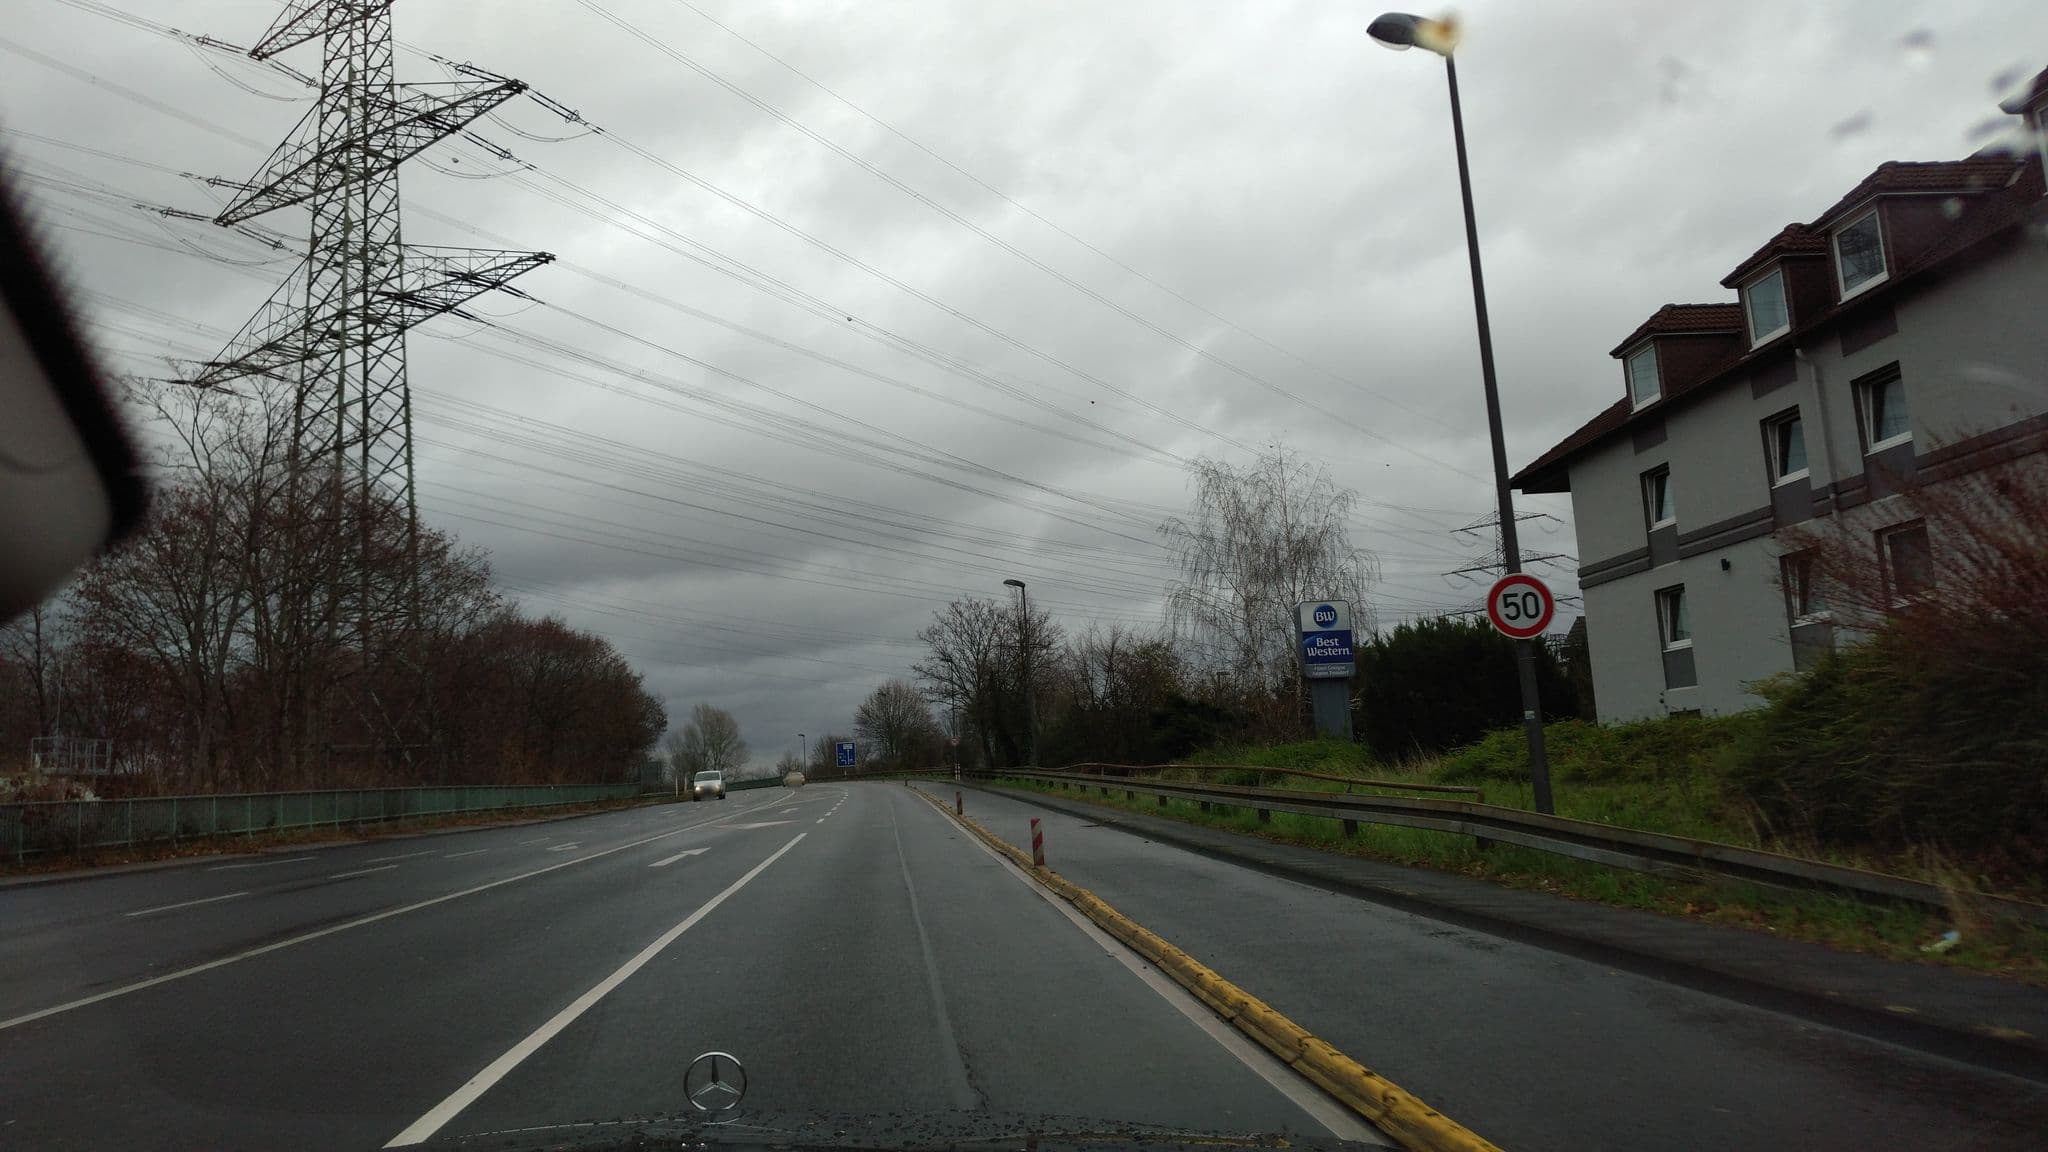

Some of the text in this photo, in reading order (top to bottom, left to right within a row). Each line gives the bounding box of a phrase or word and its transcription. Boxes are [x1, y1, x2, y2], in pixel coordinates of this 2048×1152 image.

[1502, 591, 1540, 621] 50
[1315, 611, 1335, 622] BW
[1316, 637, 1340, 647] Best
